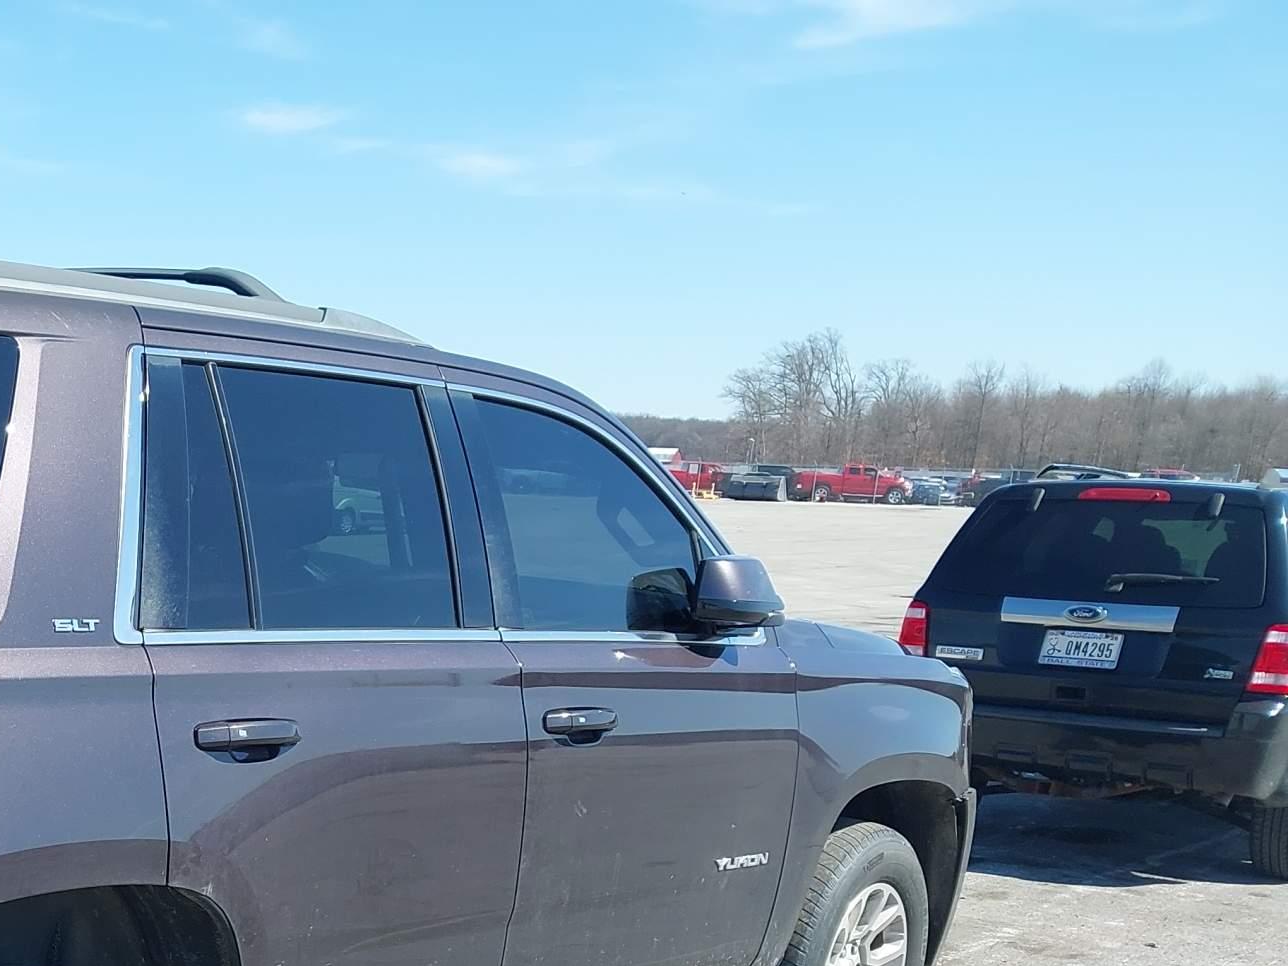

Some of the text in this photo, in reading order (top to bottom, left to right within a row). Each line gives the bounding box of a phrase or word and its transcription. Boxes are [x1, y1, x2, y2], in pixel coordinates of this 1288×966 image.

[52, 618, 100, 632] SLT
[939, 647, 980, 657] ESCAPE
[714, 852, 769, 871] YUKON
